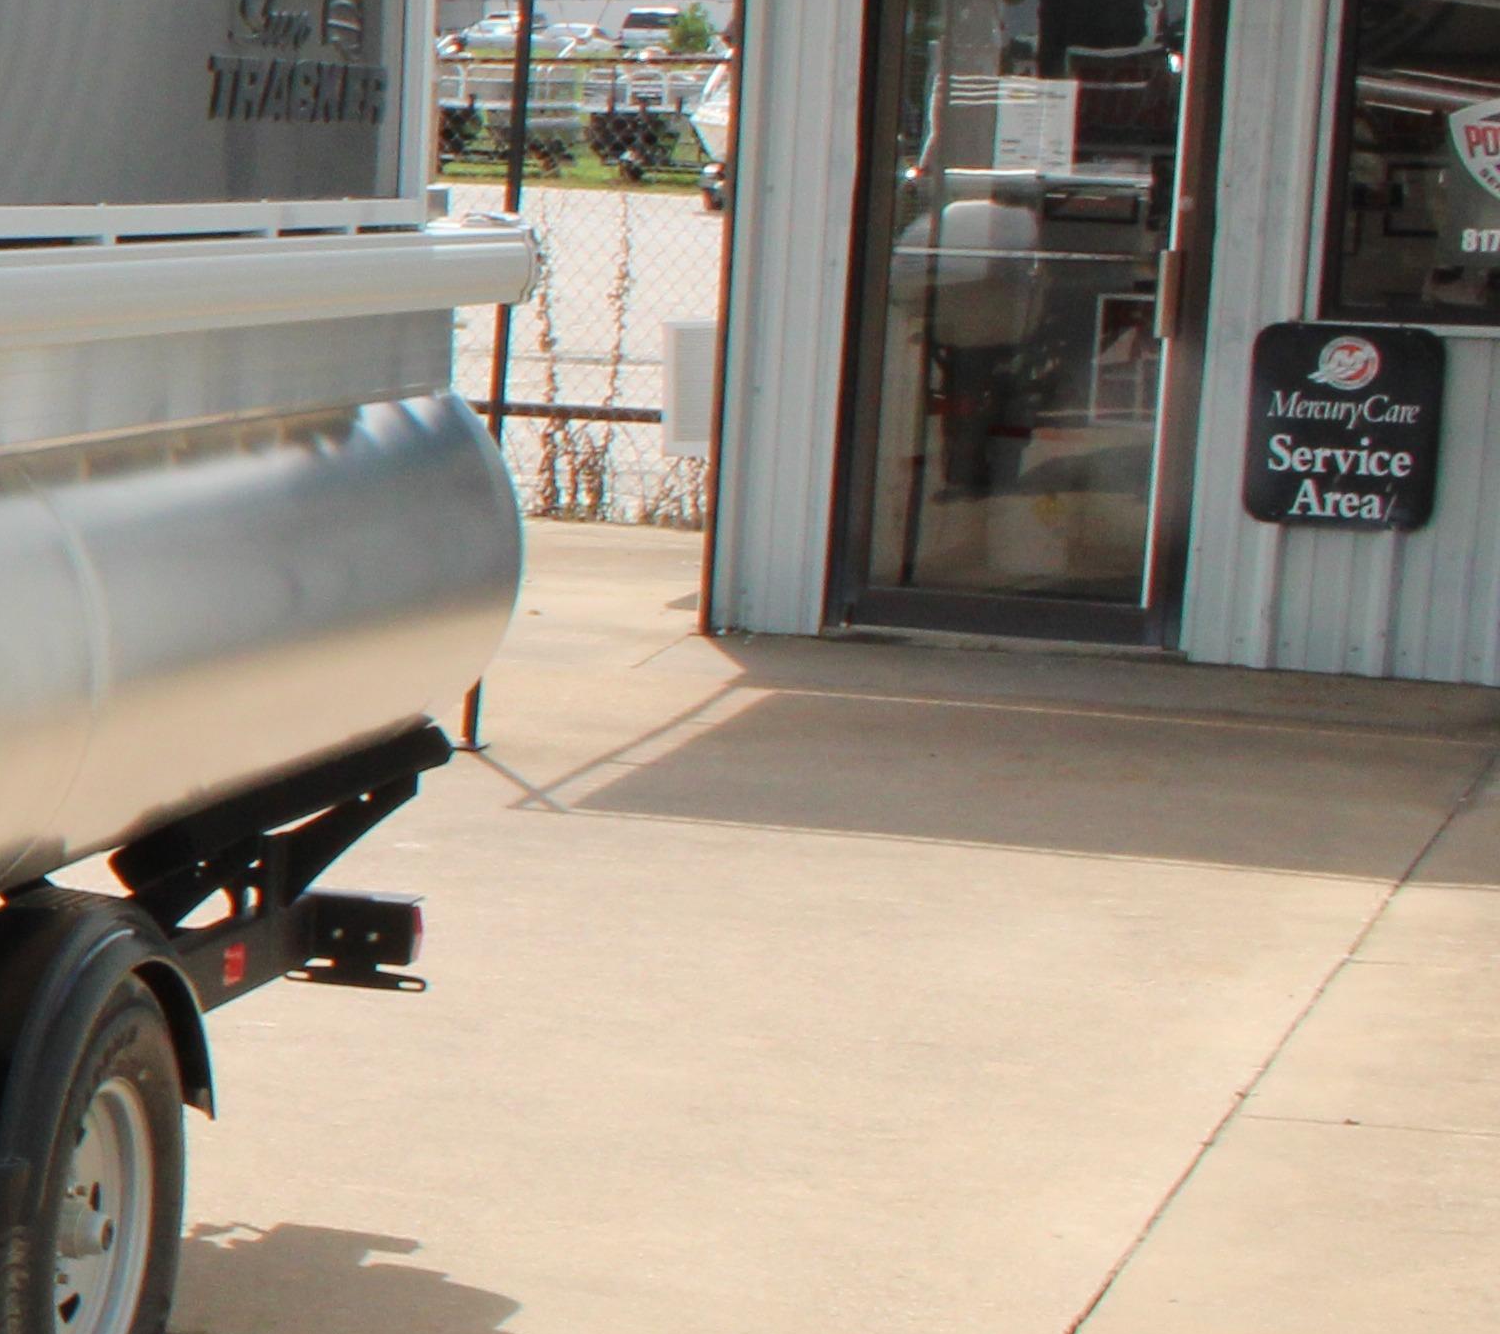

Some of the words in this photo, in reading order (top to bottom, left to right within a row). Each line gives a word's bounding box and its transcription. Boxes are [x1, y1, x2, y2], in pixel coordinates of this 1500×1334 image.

[207, 53, 388, 124] TRACKER
[1266, 390, 1421, 429] MercuryCare
[1267, 434, 1413, 478] Service
[1288, 478, 1382, 520] Area
